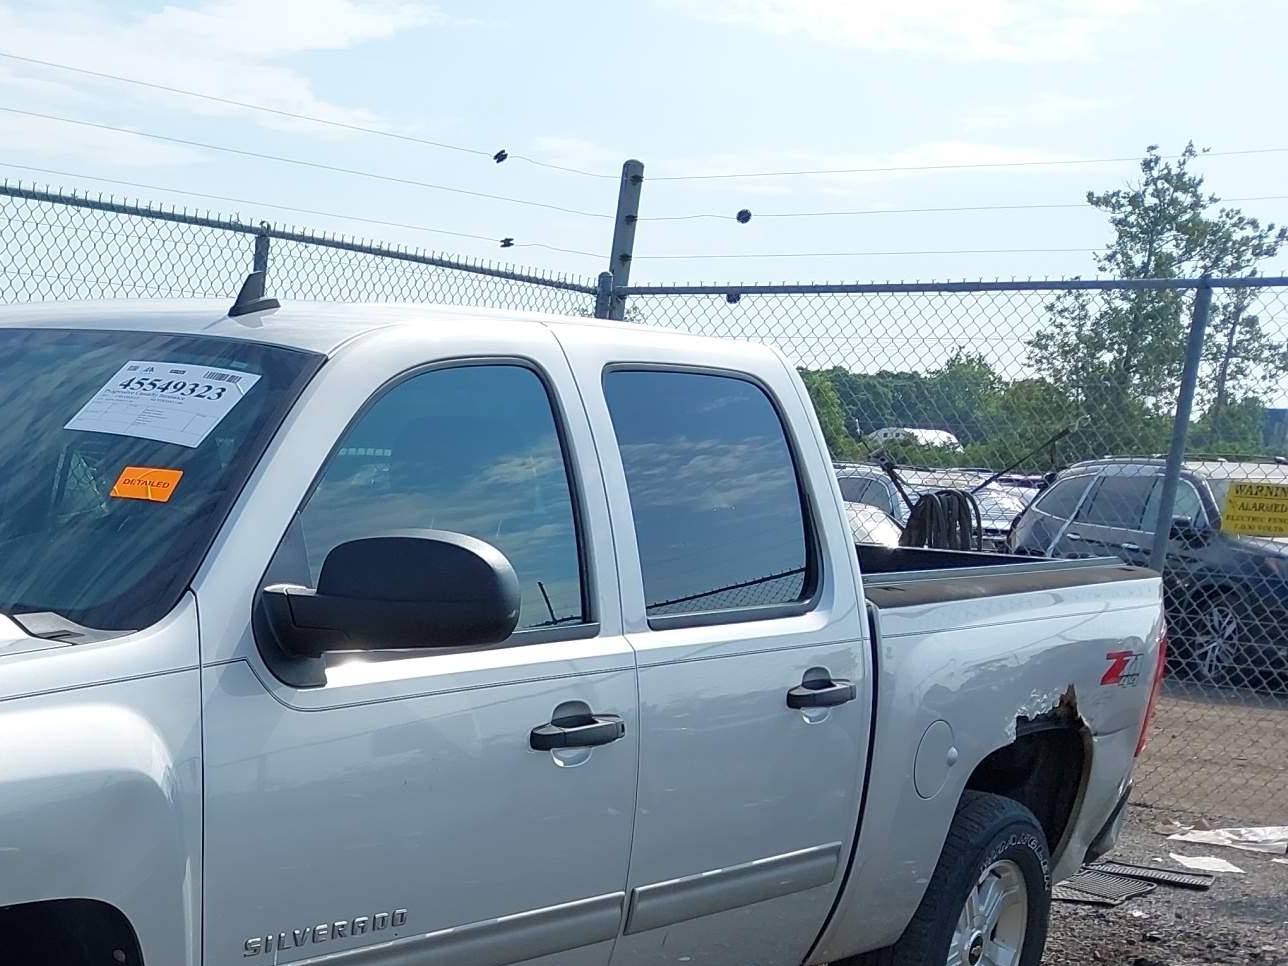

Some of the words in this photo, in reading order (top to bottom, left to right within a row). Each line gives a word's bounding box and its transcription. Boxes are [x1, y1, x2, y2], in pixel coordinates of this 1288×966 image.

[119, 376, 226, 401] 45549323
[122, 478, 170, 489] DETAILED
[1238, 502, 1288, 512] ALARMED
[243, 908, 409, 957] SILVERADO
